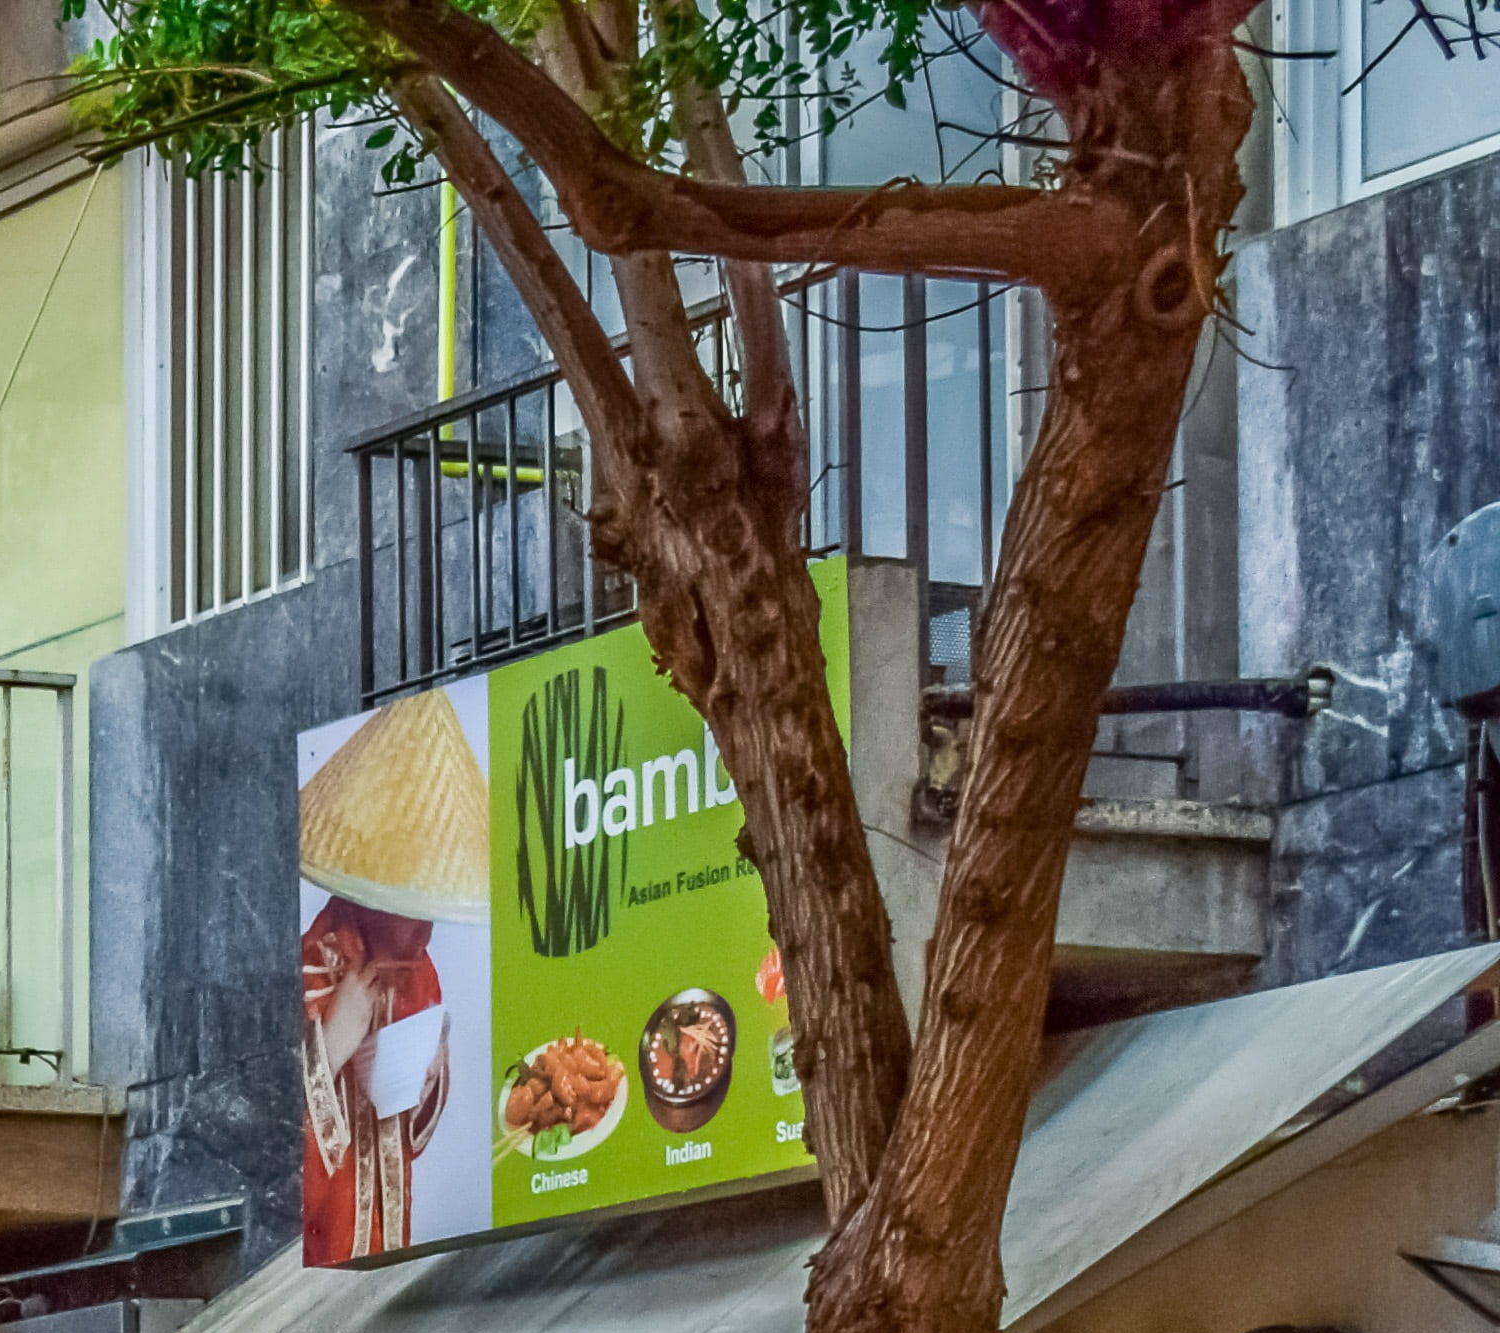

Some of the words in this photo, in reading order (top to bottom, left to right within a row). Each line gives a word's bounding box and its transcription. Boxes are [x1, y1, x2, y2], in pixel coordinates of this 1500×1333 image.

[564, 720, 737, 849] bamb
[628, 880, 671, 908] Asian
[677, 864, 729, 893] Fusion
[776, 1120, 803, 1143] Sus
[665, 1140, 712, 1166] Indian
[531, 1168, 588, 1194] Chinese
